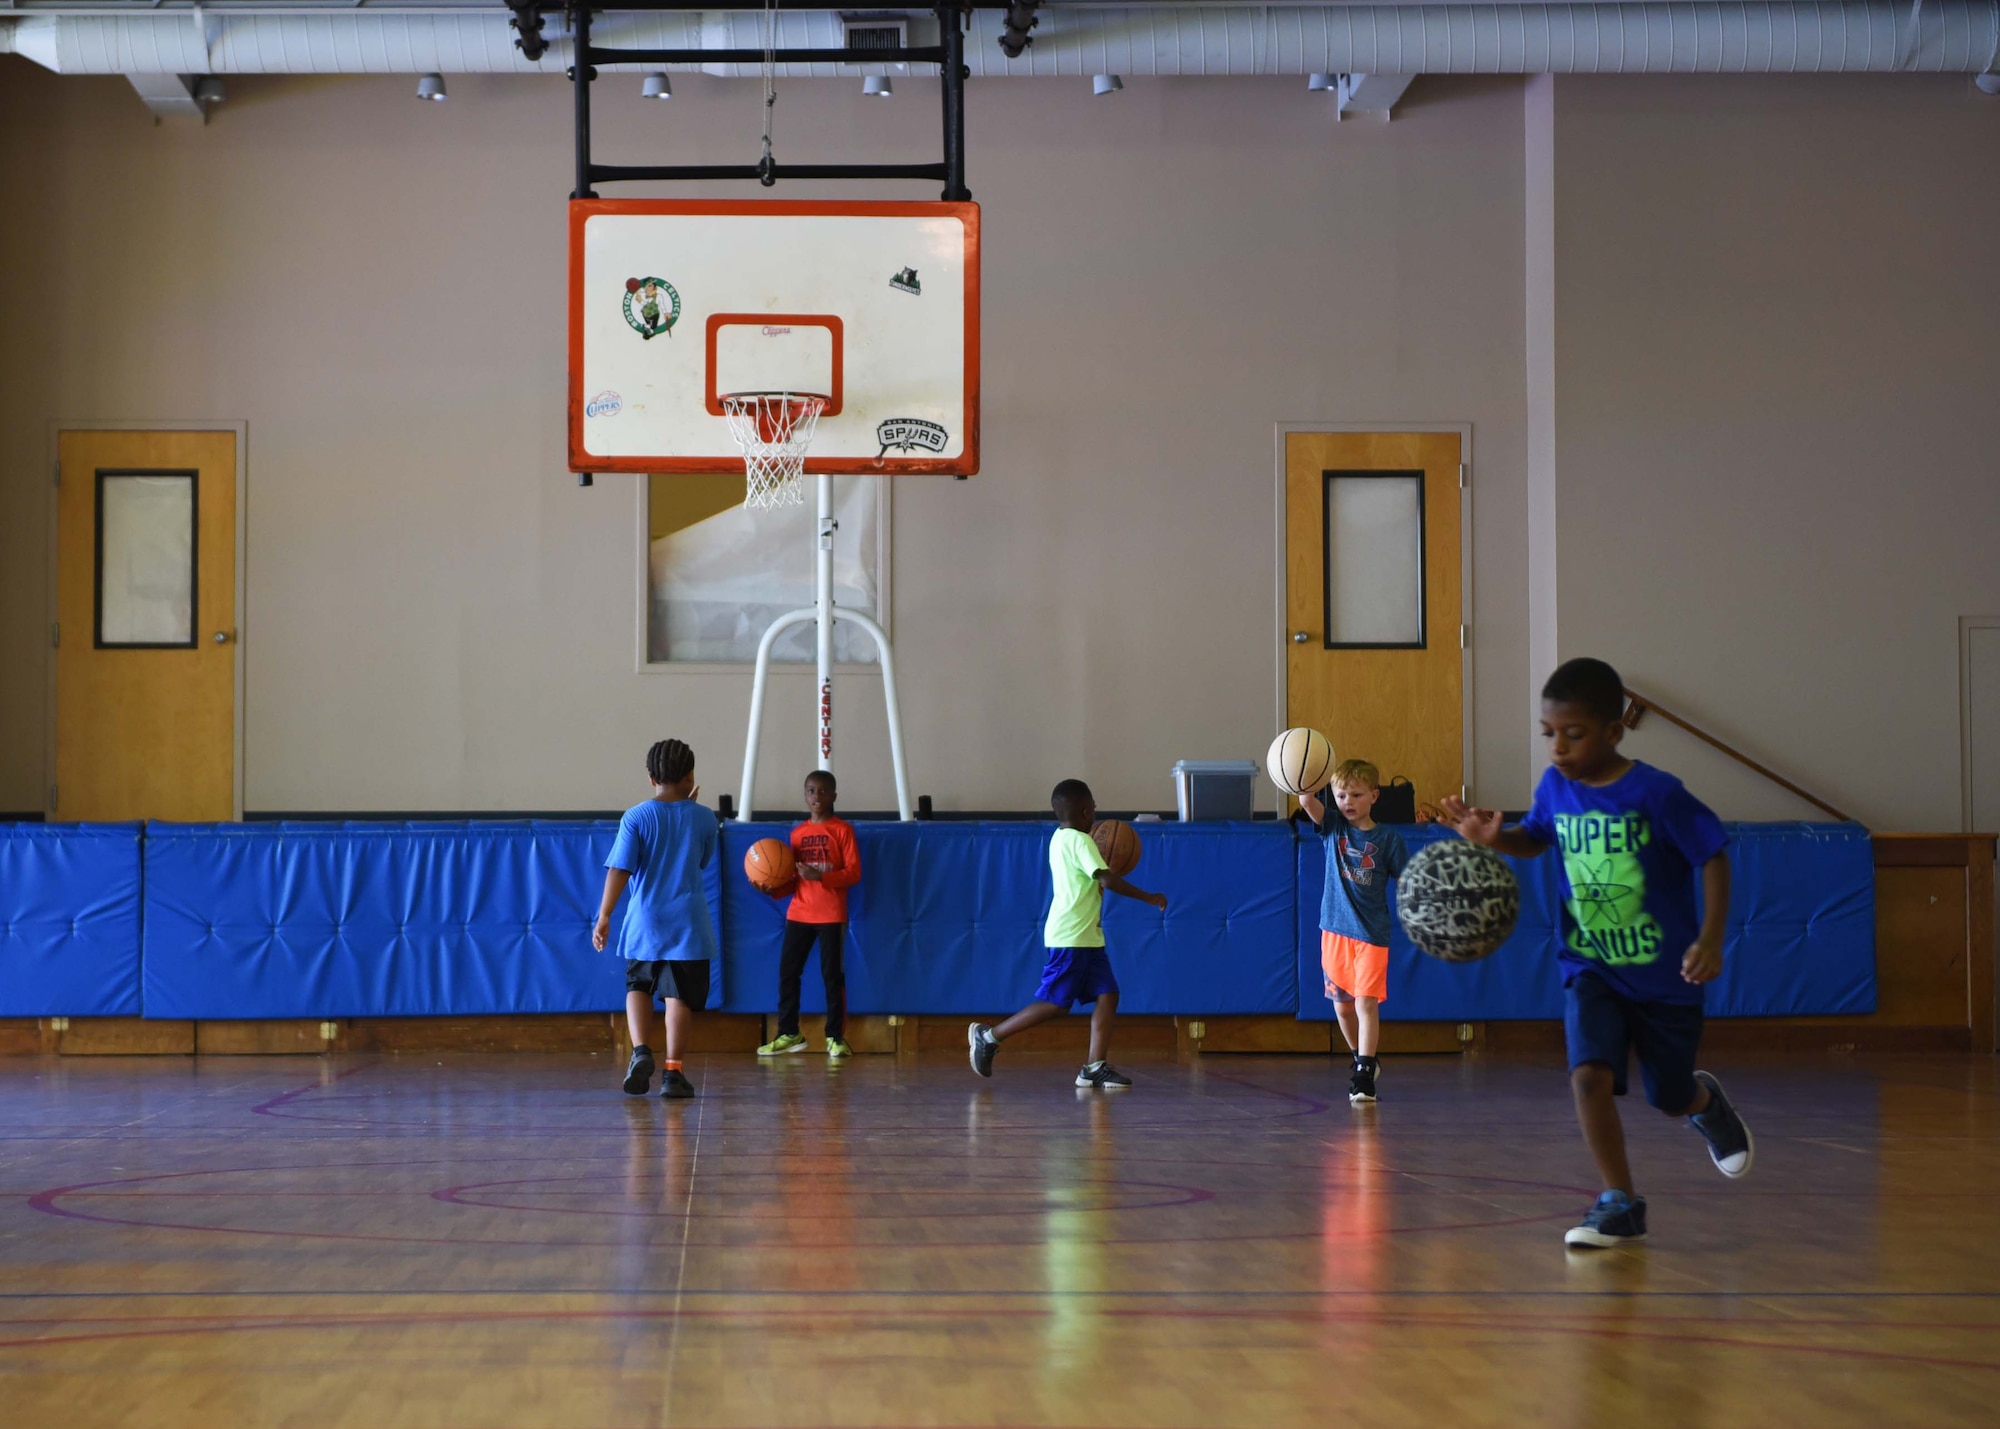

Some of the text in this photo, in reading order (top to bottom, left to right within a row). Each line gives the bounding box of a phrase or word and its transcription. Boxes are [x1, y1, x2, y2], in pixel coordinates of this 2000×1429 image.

[624, 283, 680, 327] BOSTON CELTICS
[884, 427, 941, 446] SPURS
[906, 419, 941, 430] ANTONIO
[821, 684, 832, 760] CENTURY
[801, 834, 829, 848] GOOD
[1554, 816, 1644, 855] SUPER
[1577, 922, 1661, 960] NIUS
